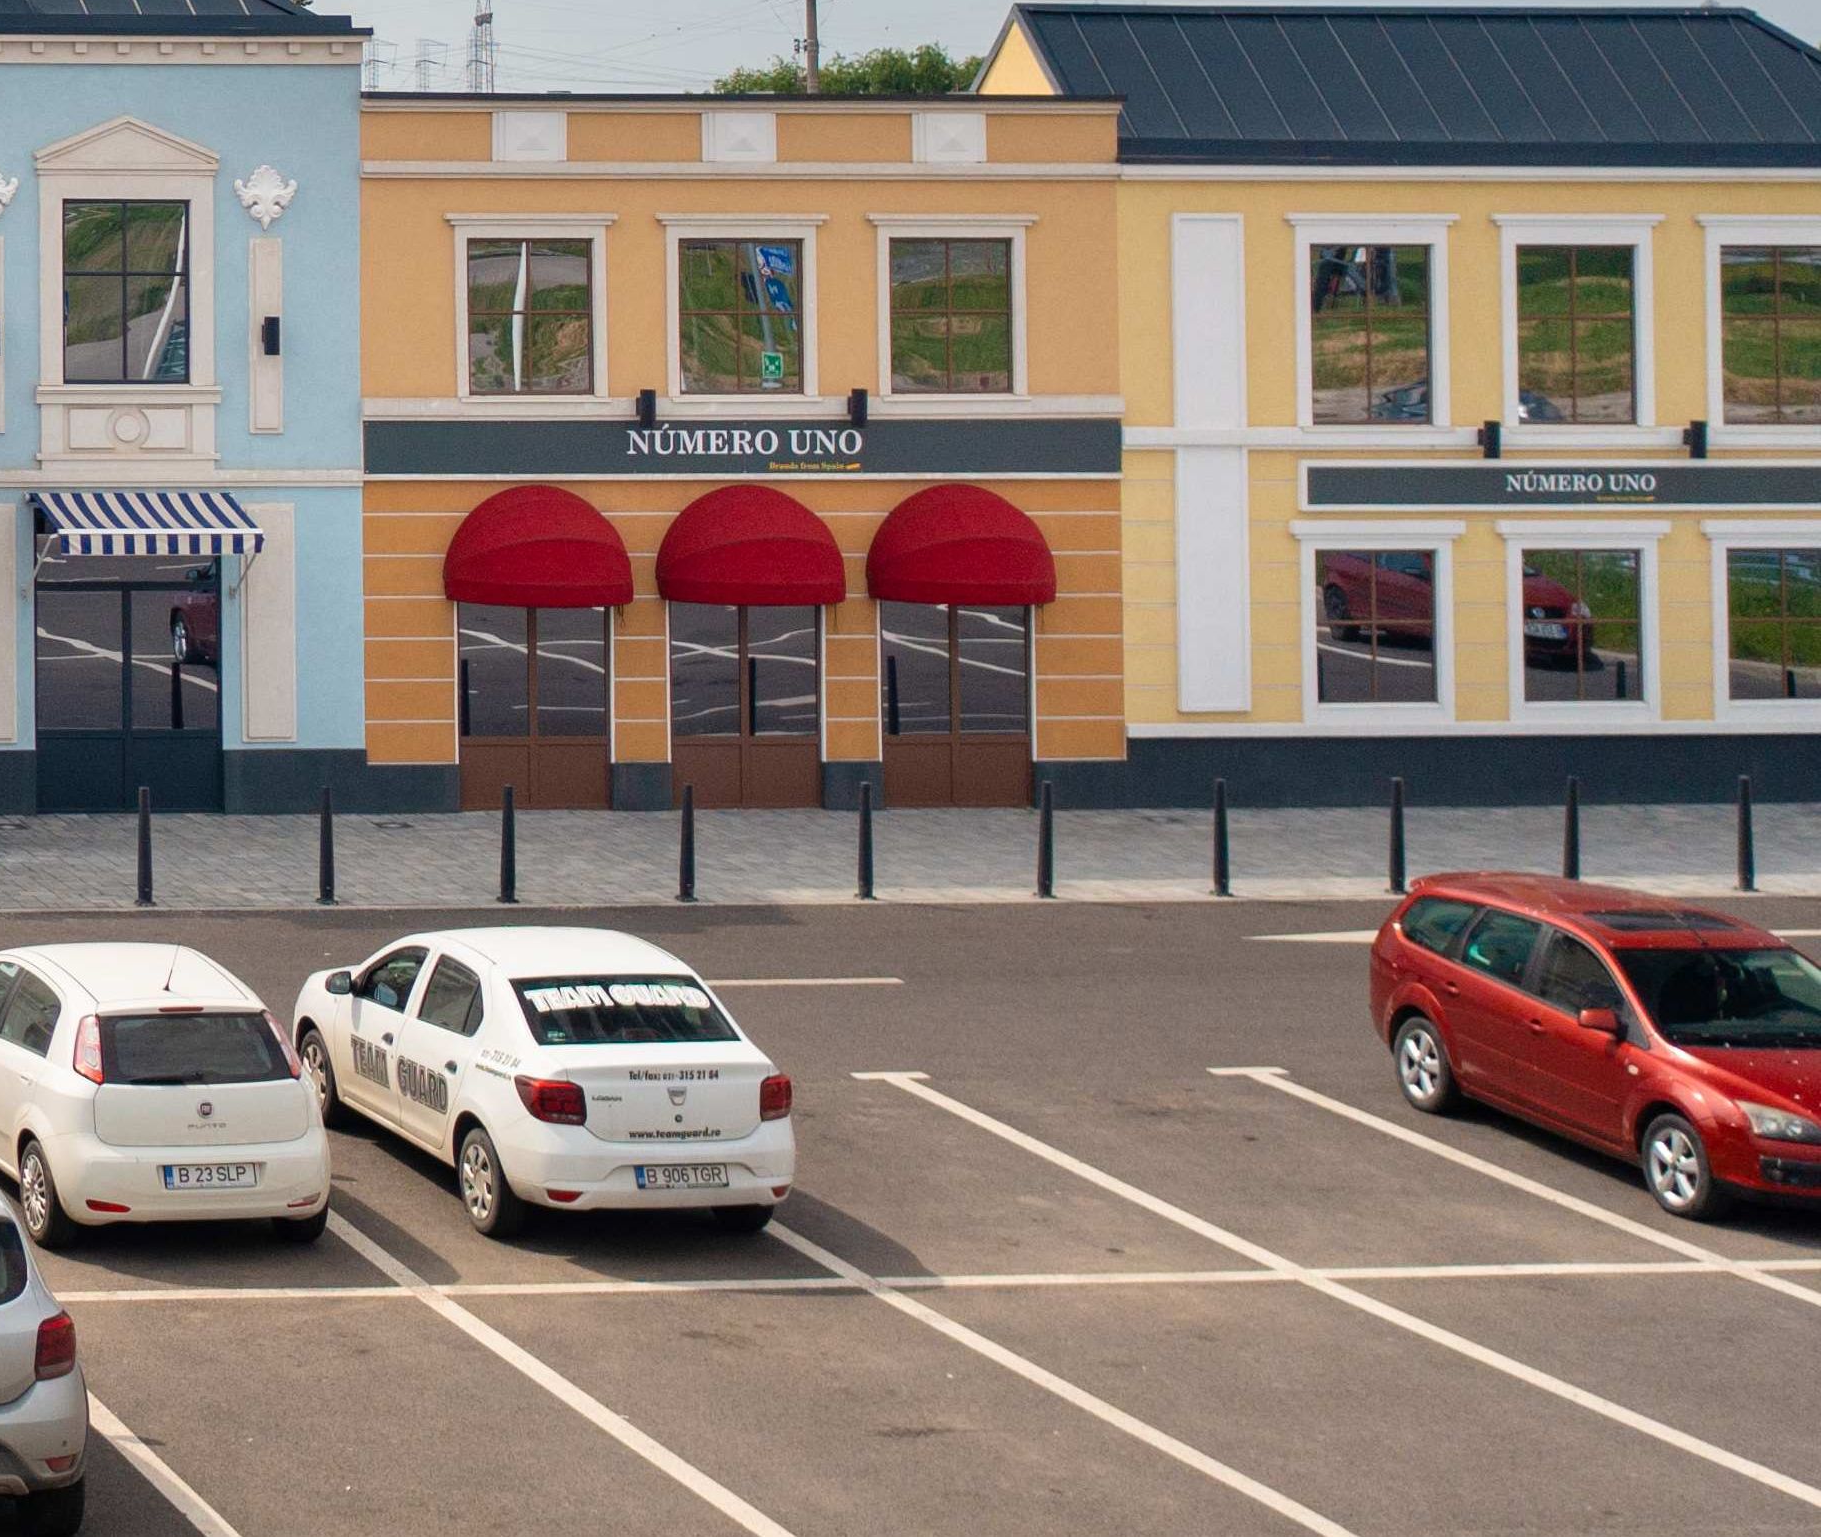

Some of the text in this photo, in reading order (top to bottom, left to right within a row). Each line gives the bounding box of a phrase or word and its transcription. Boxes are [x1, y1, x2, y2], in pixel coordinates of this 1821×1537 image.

[626, 423, 863, 455] NÚMERO UNO
[1506, 470, 1656, 492] NÚMERO UNO
[523, 984, 710, 1013] TEAM GUARD
[350, 1033, 449, 1115] TEAM GUARD
[629, 1127, 721, 1140] www.teamguard.ro
[178, 1166, 246, 1183] B 23 SLP
[645, 1167, 722, 1183] B 906 TGR
